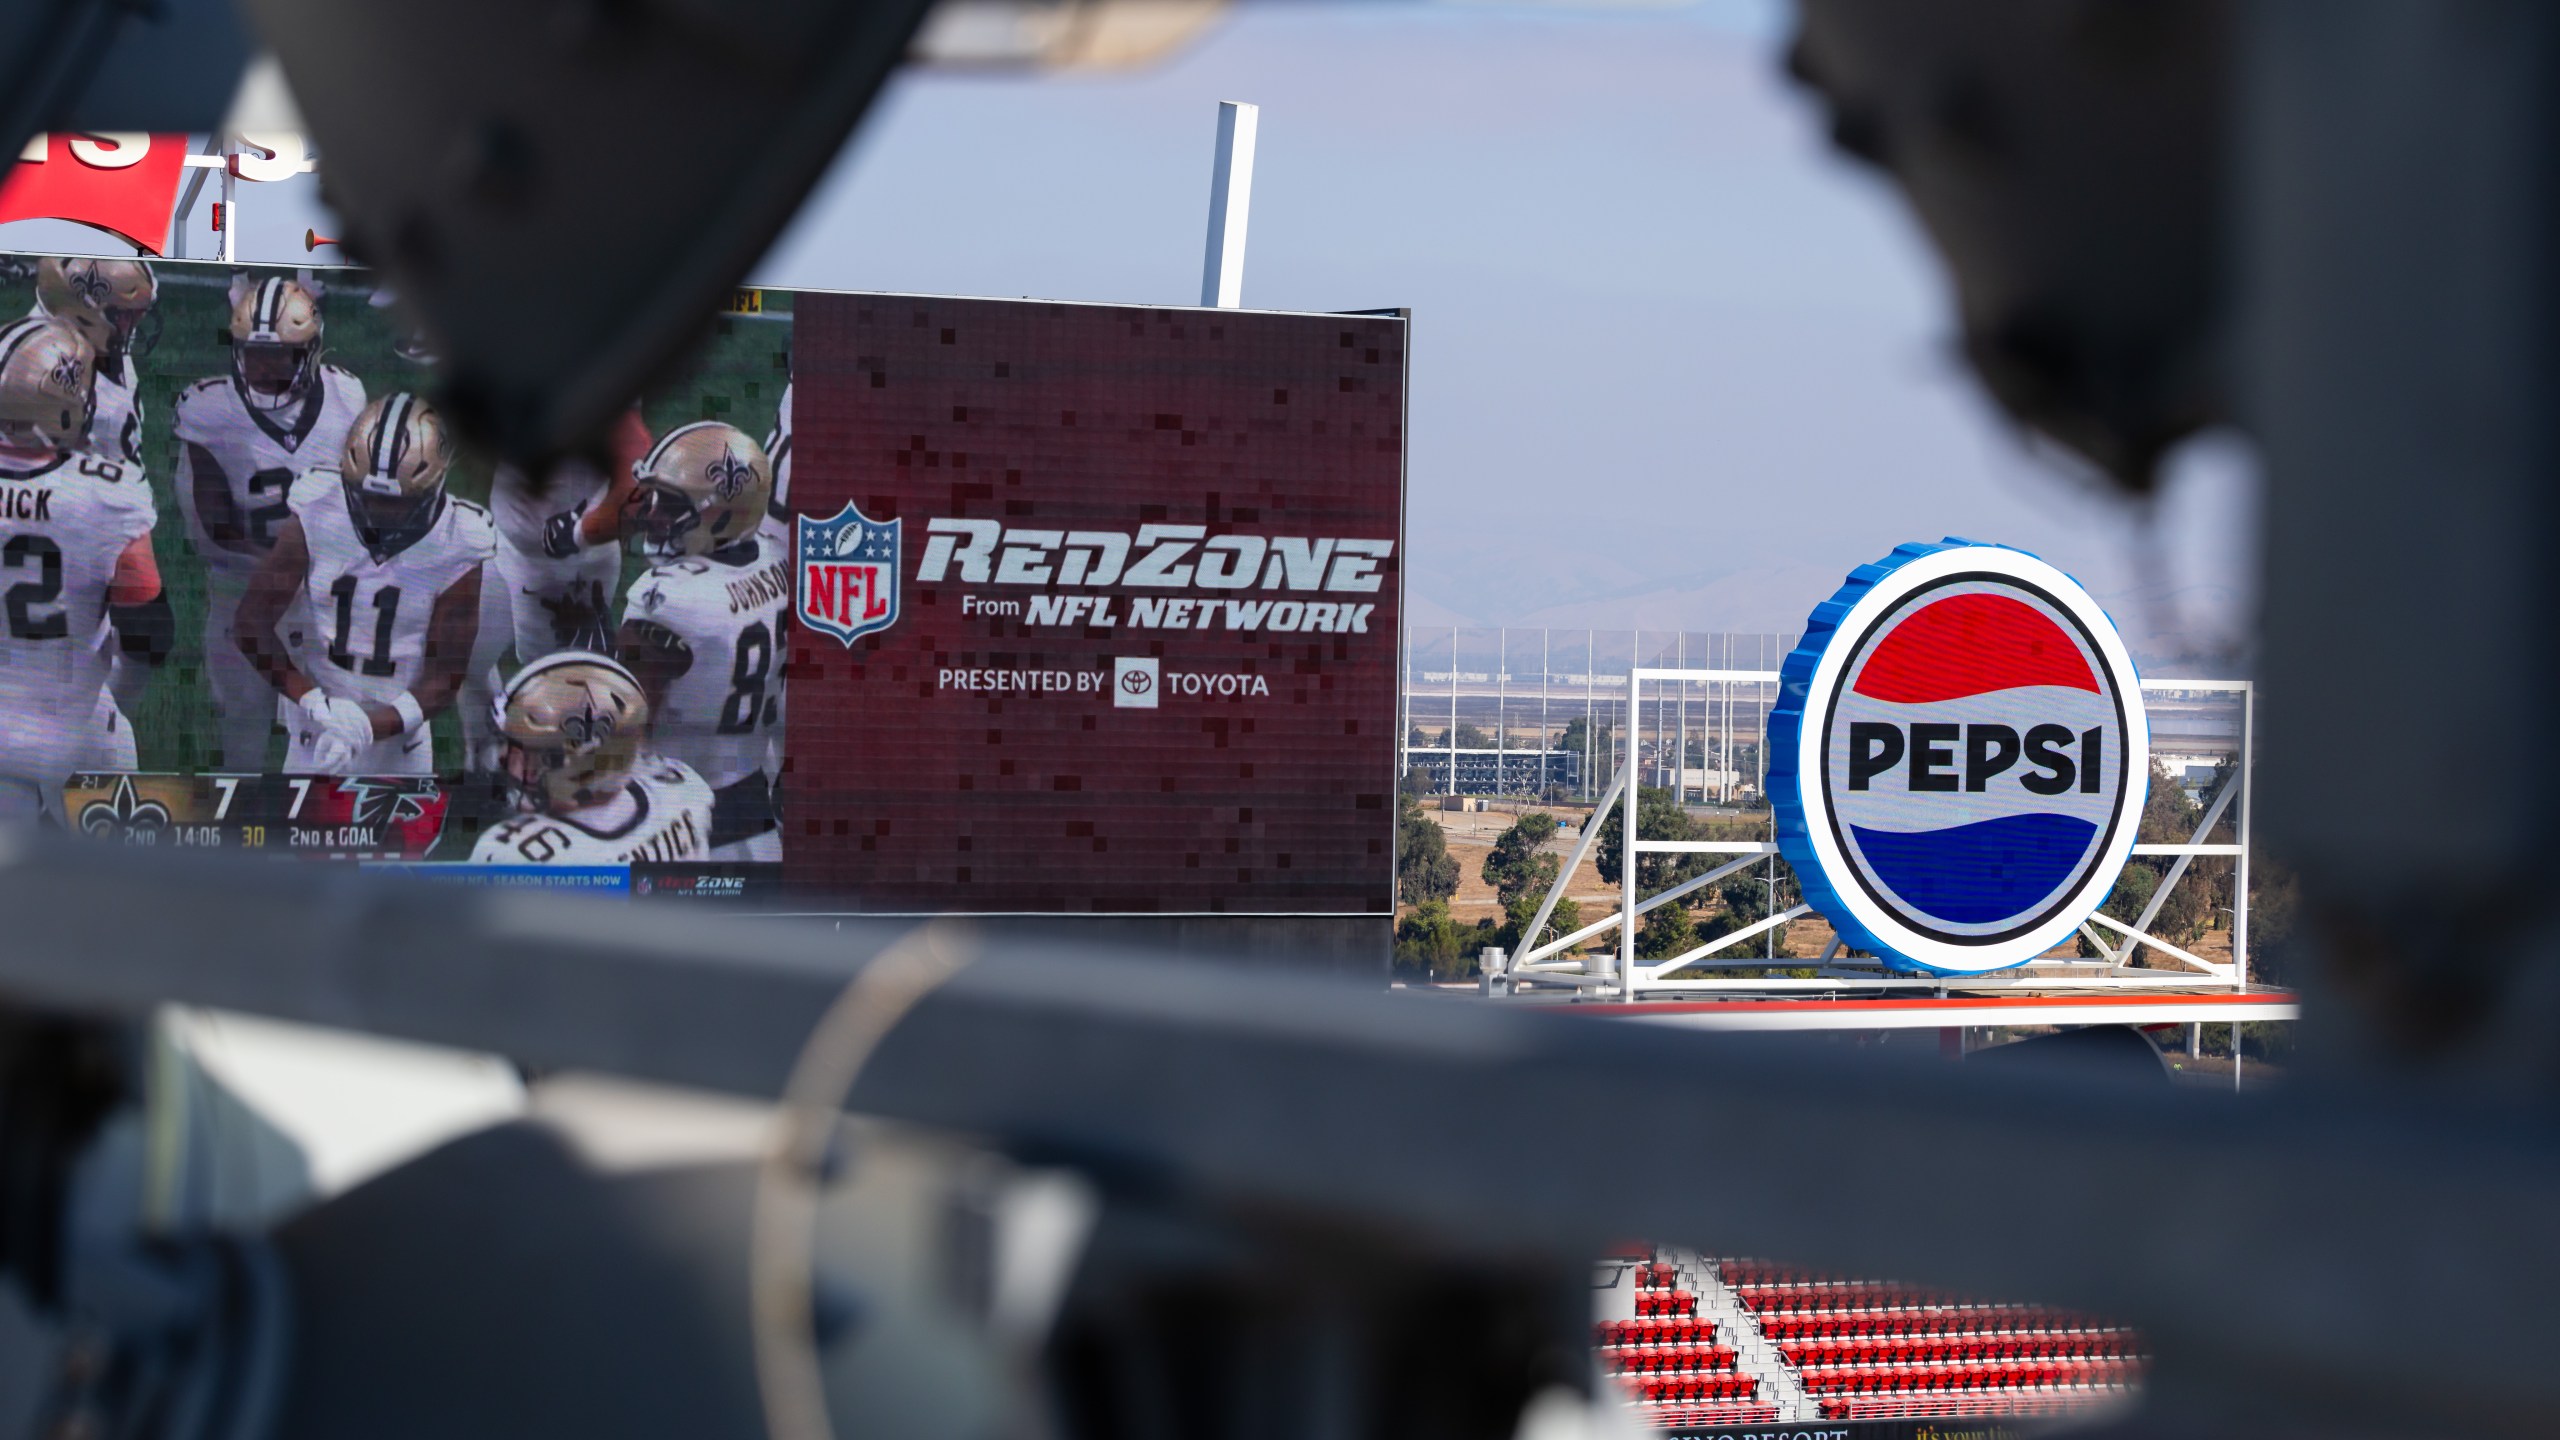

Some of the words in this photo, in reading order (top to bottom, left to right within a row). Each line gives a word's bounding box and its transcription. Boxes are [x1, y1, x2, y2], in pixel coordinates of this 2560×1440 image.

[806, 564, 888, 627] NFL
[962, 596, 1020, 616] From
[1025, 595, 1118, 628] NFL
[1127, 598, 1376, 634] NETWORK
[328, 574, 401, 678] 11
[939, 669, 1071, 692] PRESENTED
[1076, 671, 1105, 692] BY
[1167, 673, 1270, 697] TOYOTA
[1848, 722, 2102, 796] PEPSI
[214, 779, 239, 820] 7
[288, 779, 311, 819] 7
[175, 826, 221, 847] 14:06
[242, 826, 265, 847] 30
[290, 827, 320, 846] 2ND
[325, 830, 335, 845] &
[339, 826, 378, 846] GOAL
[494, 876, 542, 887] SEASON
[546, 876, 590, 886] STARTS
[593, 875, 621, 886] NOW
